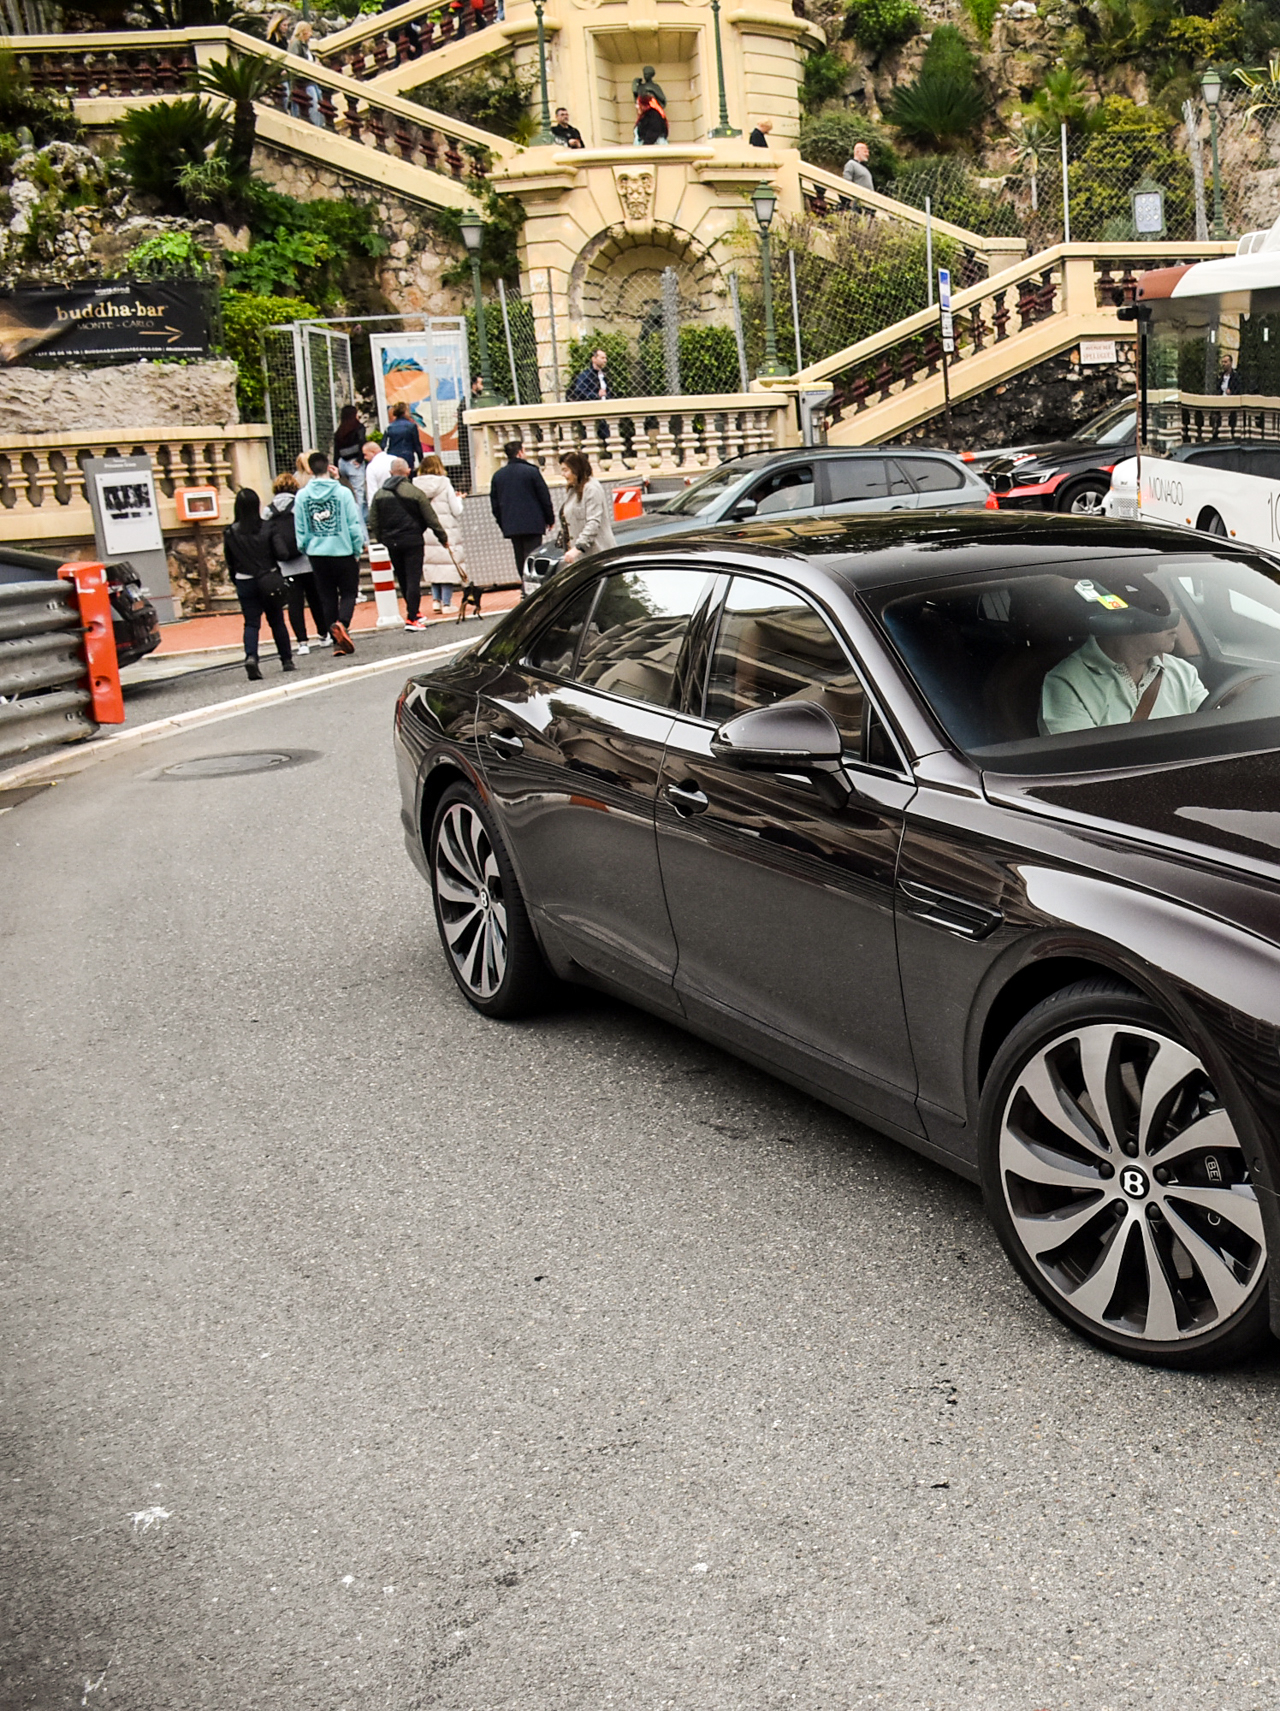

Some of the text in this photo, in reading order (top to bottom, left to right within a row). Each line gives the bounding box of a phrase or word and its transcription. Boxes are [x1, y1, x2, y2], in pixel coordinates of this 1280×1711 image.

[56, 301, 165, 321] buddha-bar
[77, 321, 114, 330] MONTE
[122, 320, 154, 328] CARLO
[1148, 476, 1184, 506] MONACO
[1207, 1161, 1220, 1181] BE
[1124, 1171, 1145, 1196] B
